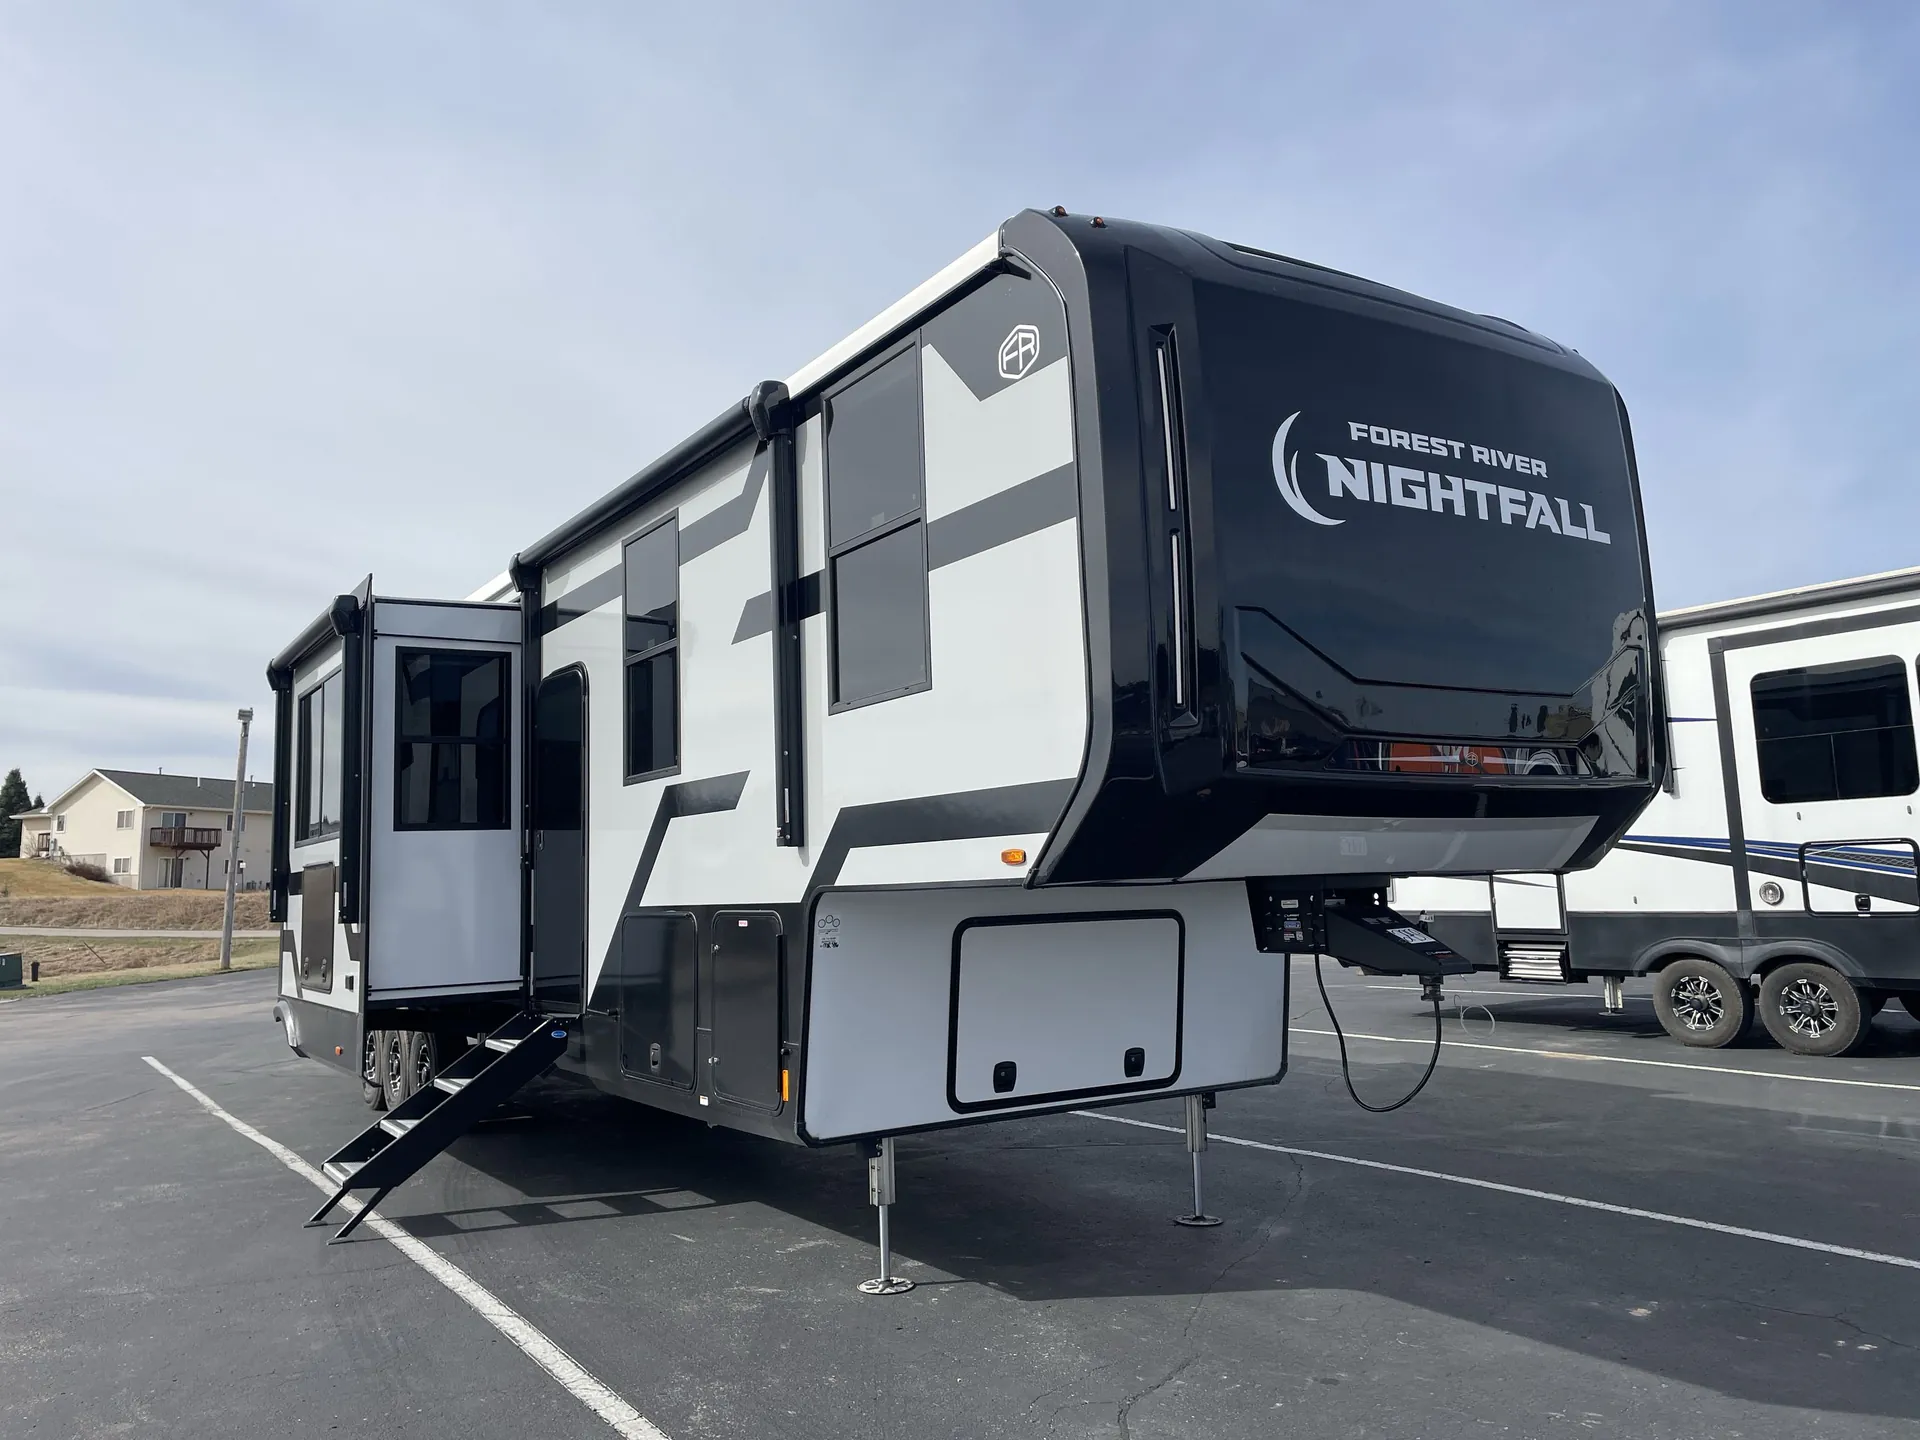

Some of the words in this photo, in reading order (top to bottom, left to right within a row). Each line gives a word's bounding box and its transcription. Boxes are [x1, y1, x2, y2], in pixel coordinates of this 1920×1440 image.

[1002, 332, 1036, 370] FR
[1347, 421, 1465, 460] FOREST
[1469, 444, 1548, 478] RIVER
[1314, 452, 1611, 545] NIGHTFALL
